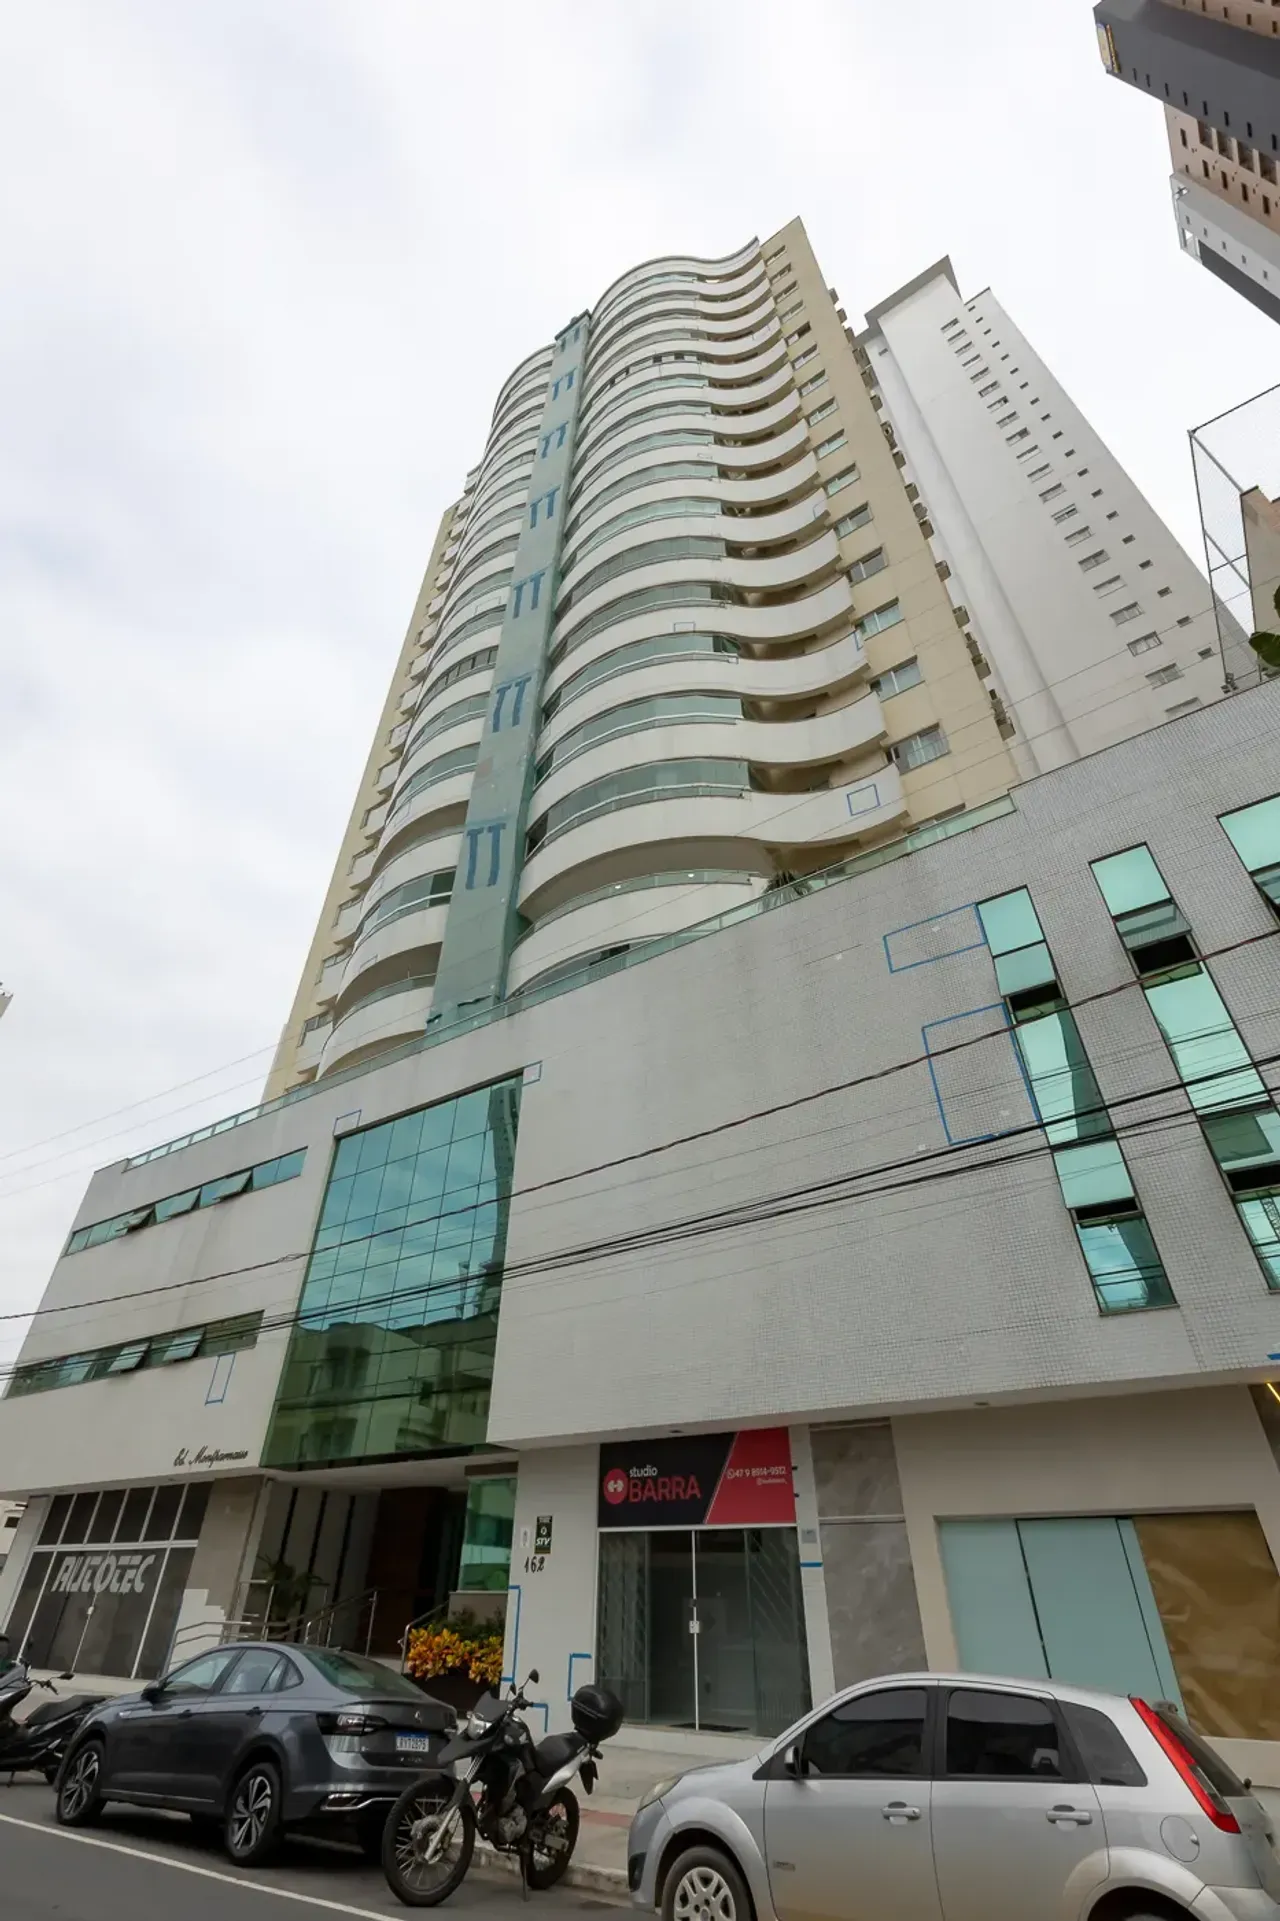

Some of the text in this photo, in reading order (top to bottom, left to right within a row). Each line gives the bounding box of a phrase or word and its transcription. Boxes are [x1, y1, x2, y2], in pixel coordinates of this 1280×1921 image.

[629, 1465, 658, 1477] studio
[629, 1476, 700, 1502] BARRA
[535, 1537, 550, 1546] STV
[524, 1556, 545, 1573] 162
[50, 1554, 156, 1593] AUTOTEC
